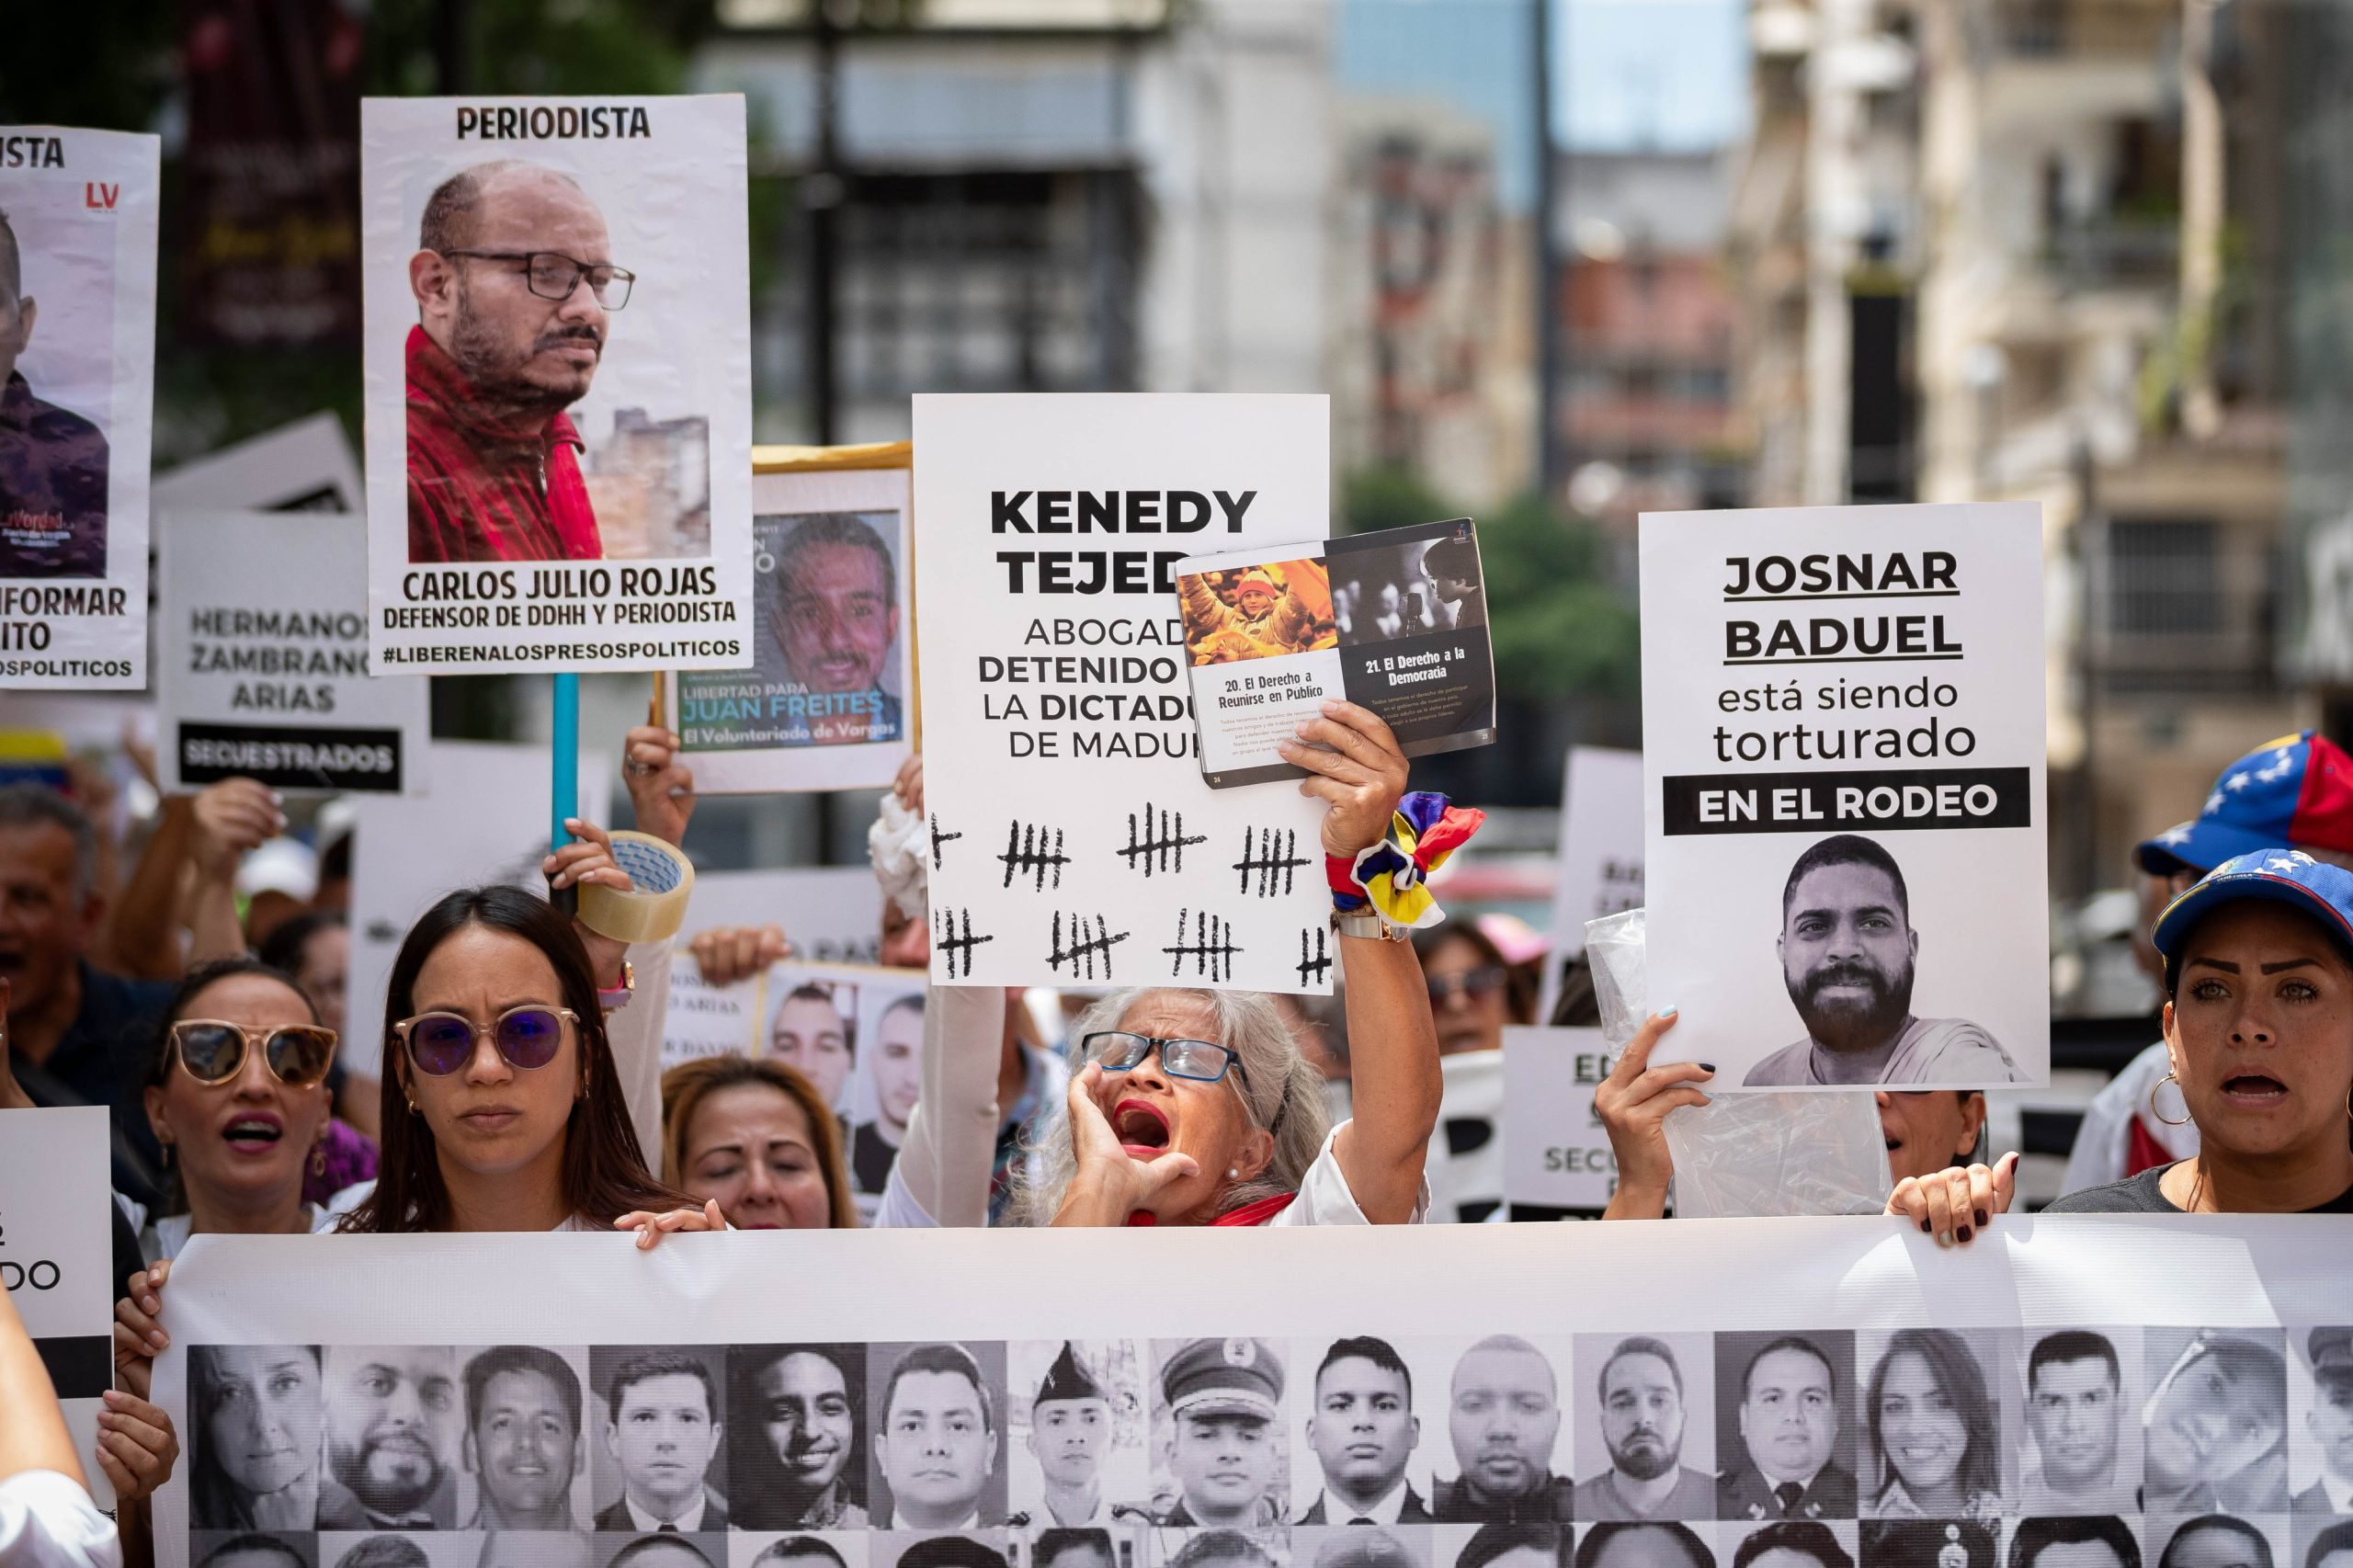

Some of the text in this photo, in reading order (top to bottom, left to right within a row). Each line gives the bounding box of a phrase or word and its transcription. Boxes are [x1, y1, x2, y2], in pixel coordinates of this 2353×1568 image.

[457, 106, 652, 140] PERIODISTA
[86, 182, 119, 210] LV
[991, 490, 1257, 534] KENEDY
[403, 565, 717, 601] CARLOS JULIO ROJAS
[996, 551, 1195, 595] TEJED
[1722, 551, 1959, 596] JOSNAR
[191, 608, 369, 641] HERMANO
[383, 600, 736, 630] DEFENSOR DE DDHH Y PERIODISTA
[1024, 618, 1186, 645] ABOGAD
[1725, 614, 1963, 658] BADUEL
[383, 640, 741, 664] #LIBERENALOSPRESOSPOLITICOS
[1366, 647, 1465, 674] 21. El Derecho a la
[979, 656, 1177, 684] DETENIDO
[1225, 672, 1312, 692] 20. El Derecho a
[1389, 665, 1447, 687] Democracia
[232, 682, 335, 712] ARIAS
[684, 682, 810, 699] LIBERTAD PARA
[1219, 693, 1264, 709] Reunirse
[1269, 692, 1282, 702] en
[1718, 676, 1959, 712] está siendo
[684, 690, 884, 722] JUAN FREITES
[984, 694, 1029, 720] LA
[684, 722, 895, 744] El Voluntariado de Vargas
[1011, 732, 1059, 757] DE
[1713, 716, 1976, 763] torturado
[185, 739, 394, 773] SECUESTRADOS
[1699, 784, 1997, 823] EN EL RODEO
